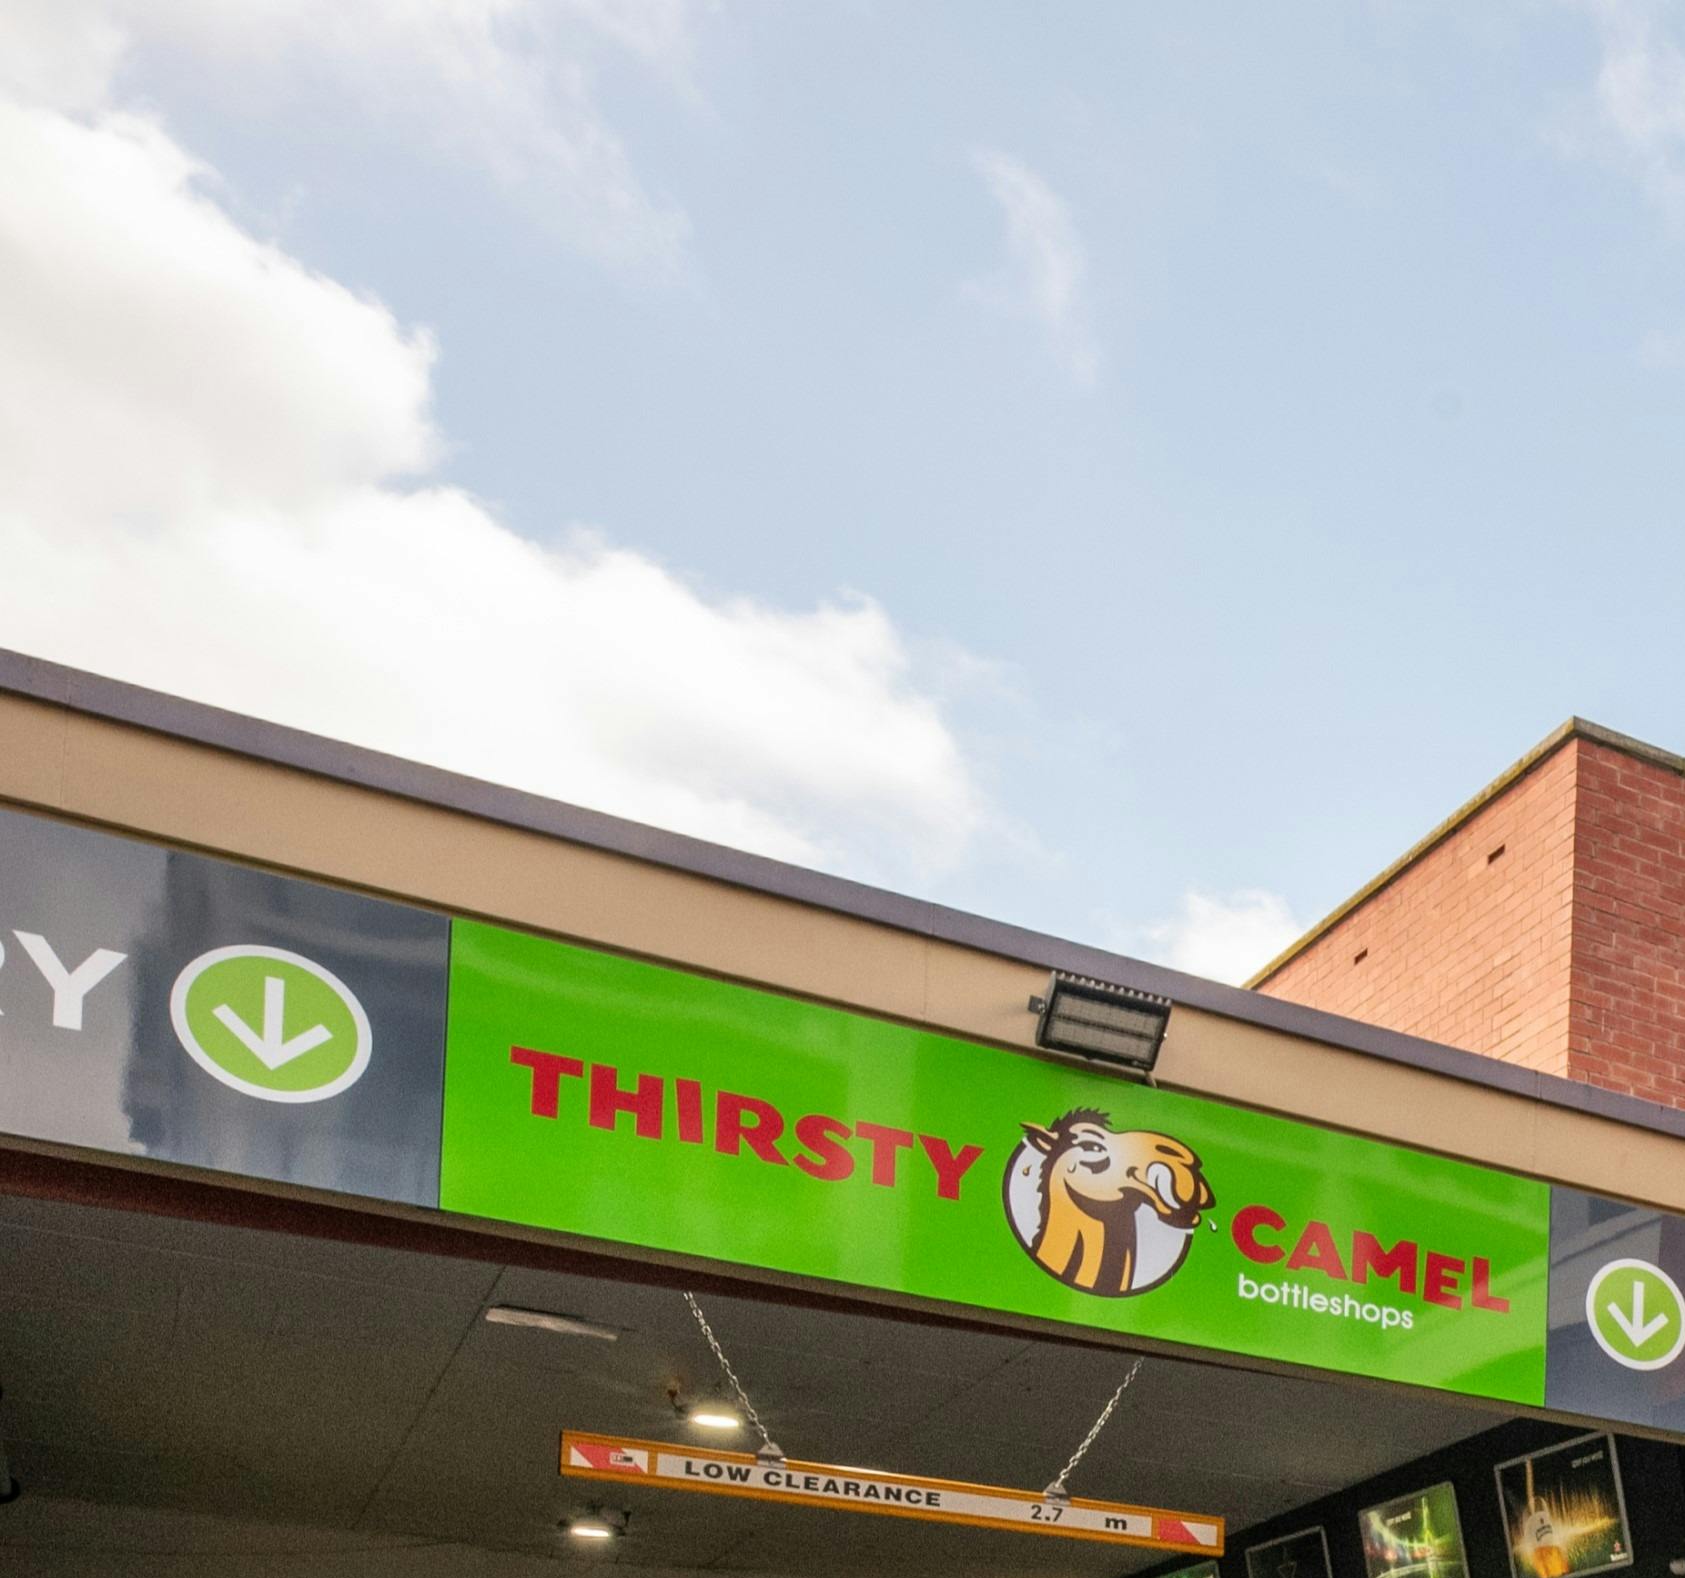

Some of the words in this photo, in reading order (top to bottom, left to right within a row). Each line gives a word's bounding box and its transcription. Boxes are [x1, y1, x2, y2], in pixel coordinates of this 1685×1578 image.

[0, 928, 128, 1031] Y
[509, 1045, 985, 1202] THIRSTY
[1231, 1205, 1511, 1315] CAMEL
[1237, 1272, 1414, 1331] bottleshops
[684, 1461, 750, 1482] LOW
[764, 1470, 941, 1507] CLEARANCE
[1030, 1504, 1064, 1522] 2.7
[1104, 1516, 1127, 1530] m
